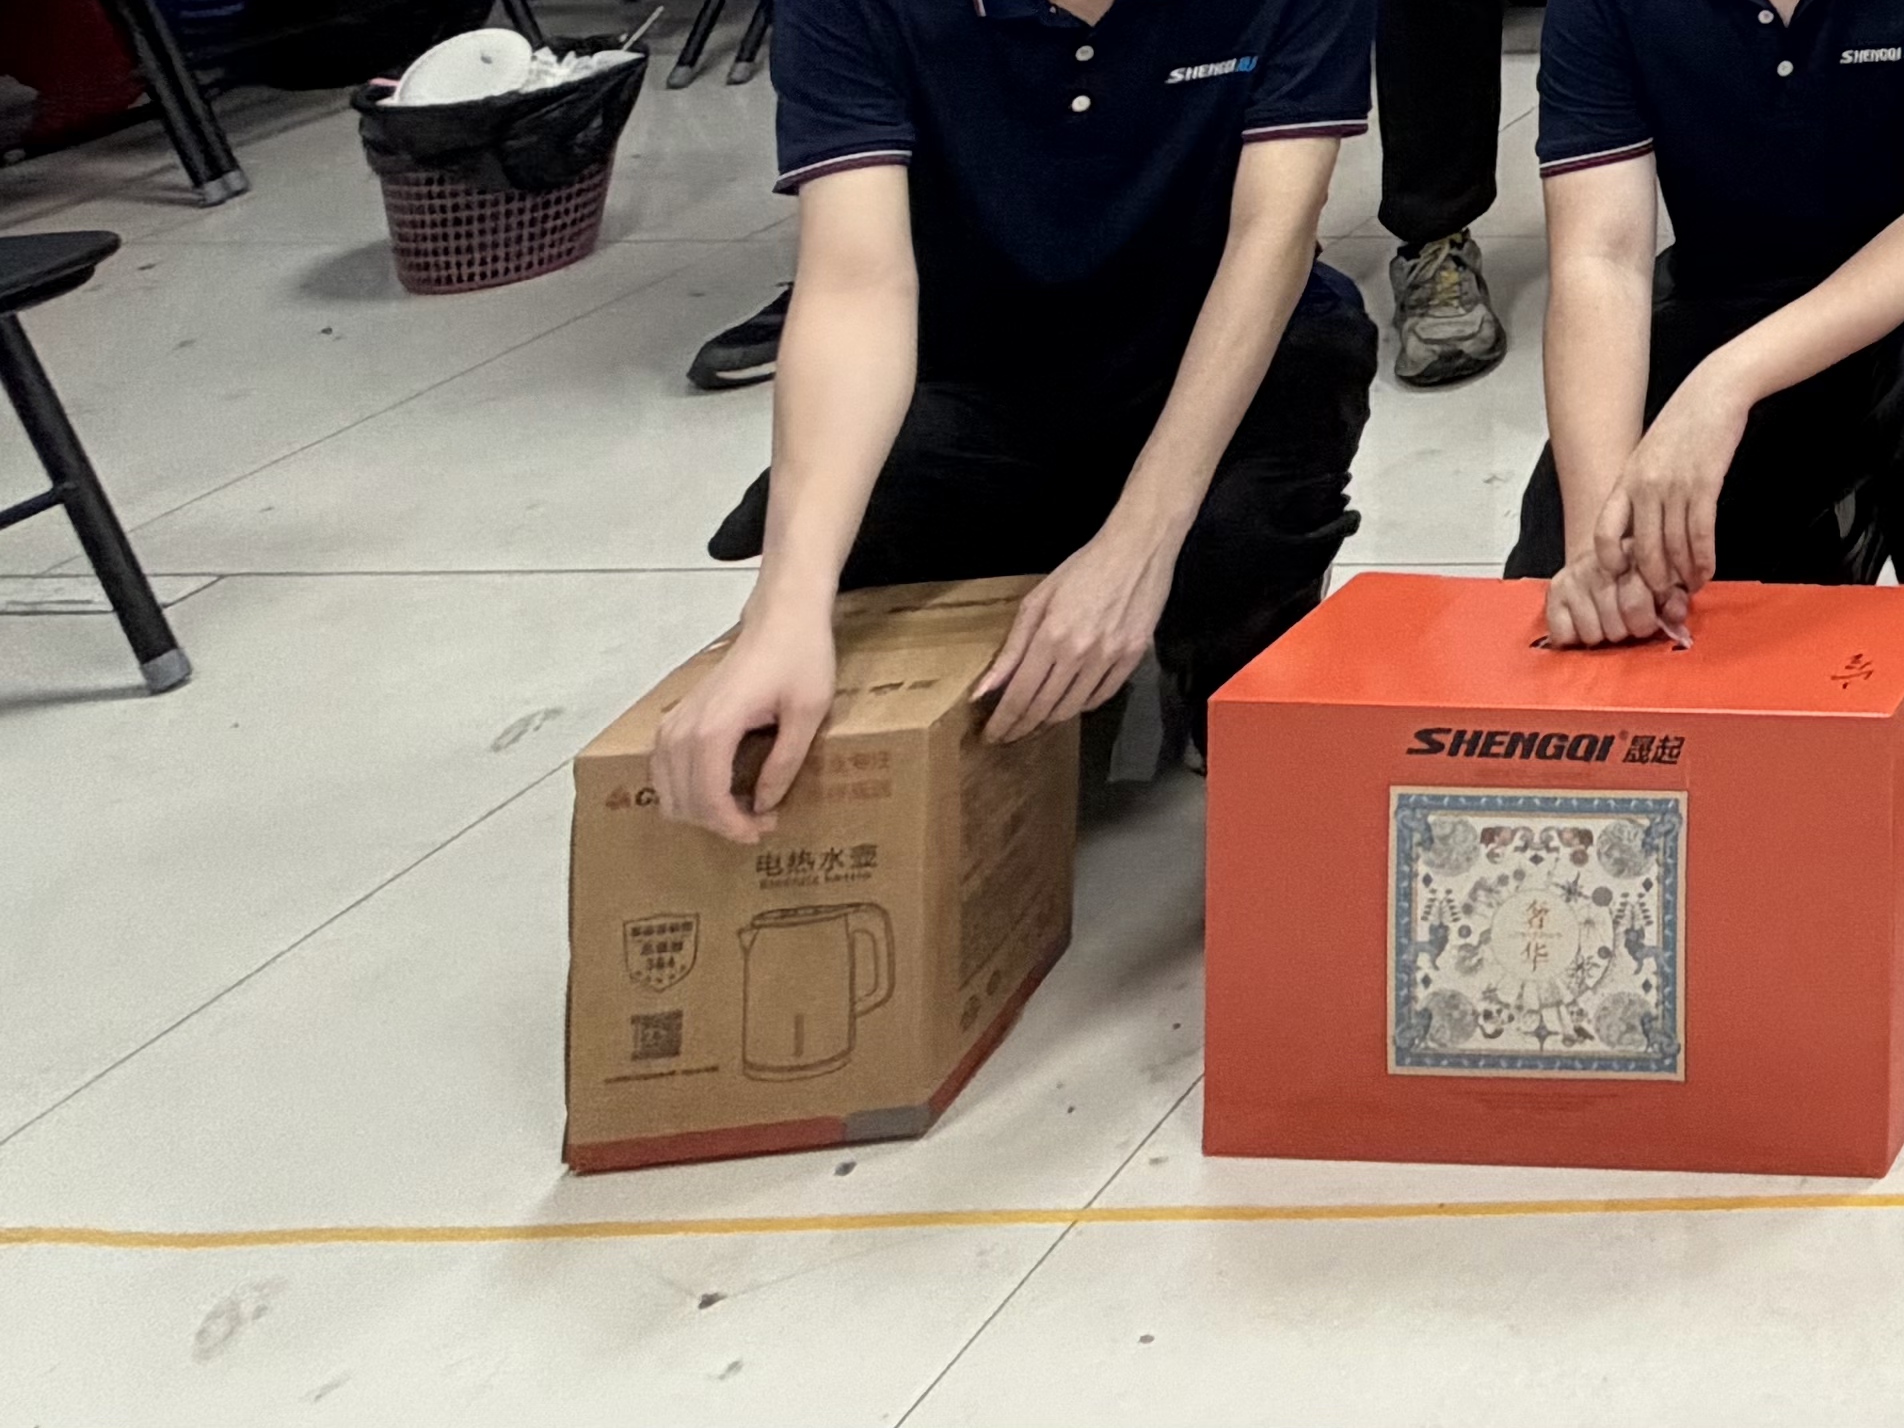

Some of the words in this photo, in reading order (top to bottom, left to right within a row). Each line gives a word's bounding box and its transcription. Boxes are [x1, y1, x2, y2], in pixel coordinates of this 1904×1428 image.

[1405, 727, 1616, 763] SHENGQI
[1622, 734, 1686, 765] 晟起
[755, 844, 879, 877] 电热水壶
